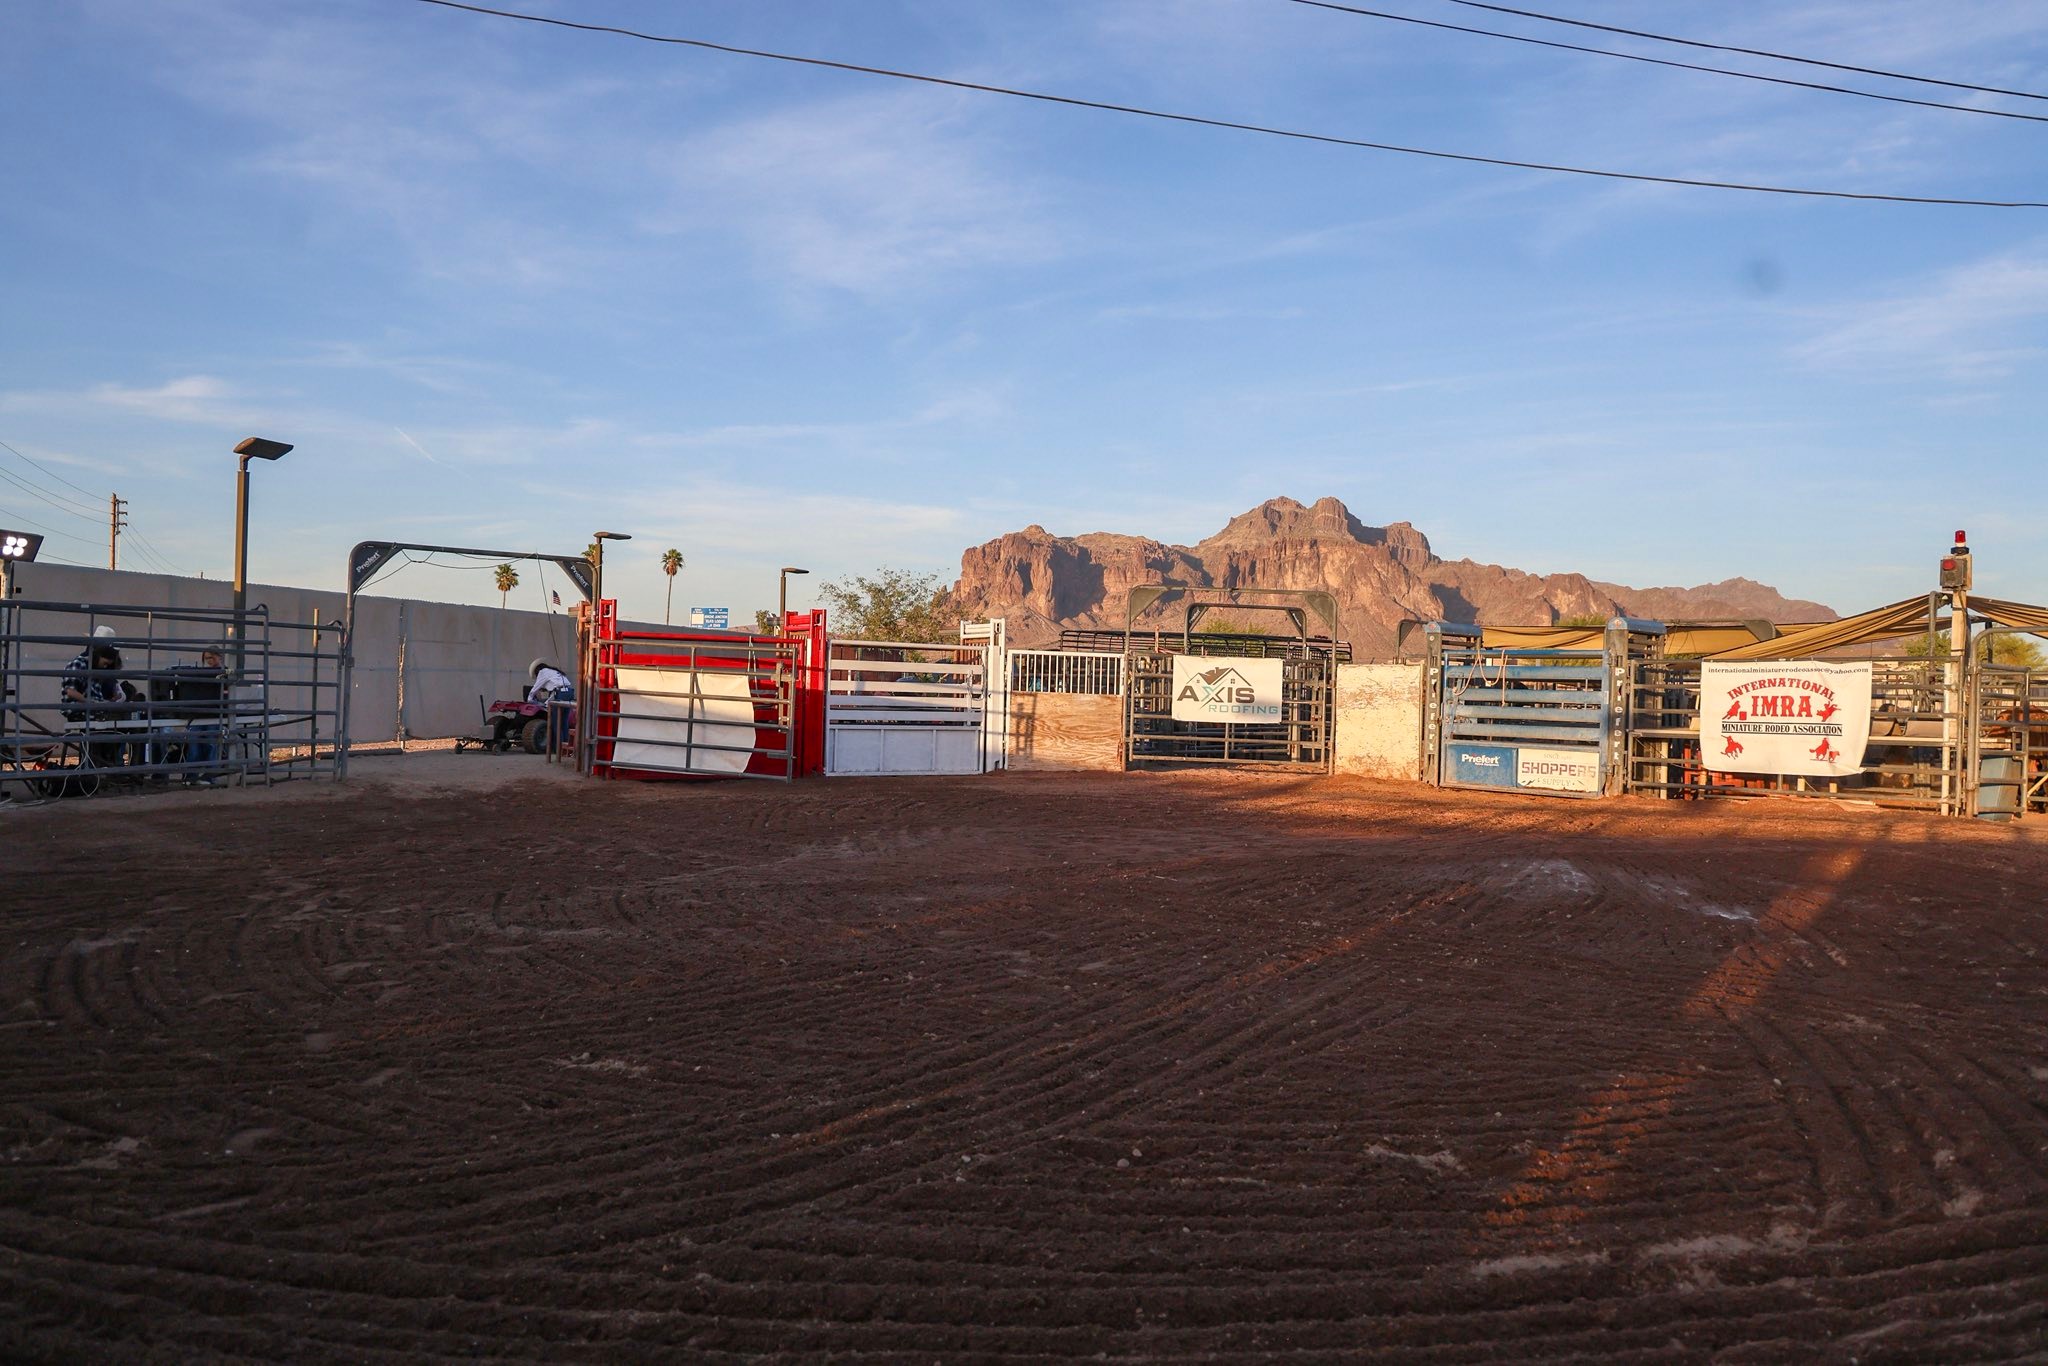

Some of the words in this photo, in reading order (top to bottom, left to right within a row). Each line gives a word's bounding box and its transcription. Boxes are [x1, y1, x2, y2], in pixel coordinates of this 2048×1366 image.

[1176, 685, 1255, 706] AXIS
[1727, 677, 1835, 701] INTERNATIONAL
[1208, 704, 1279, 715] ROOFING
[1750, 695, 1813, 718] IMRA
[1721, 723, 1763, 733] MINIATURE
[1765, 725, 1790, 733] RODEO
[1793, 725, 1843, 735] ASSOCIATION
[1461, 753, 1500, 764] Priefert
[1521, 761, 1597, 778] SHOPPERS
[1541, 777, 1572, 787] SUPPLY
